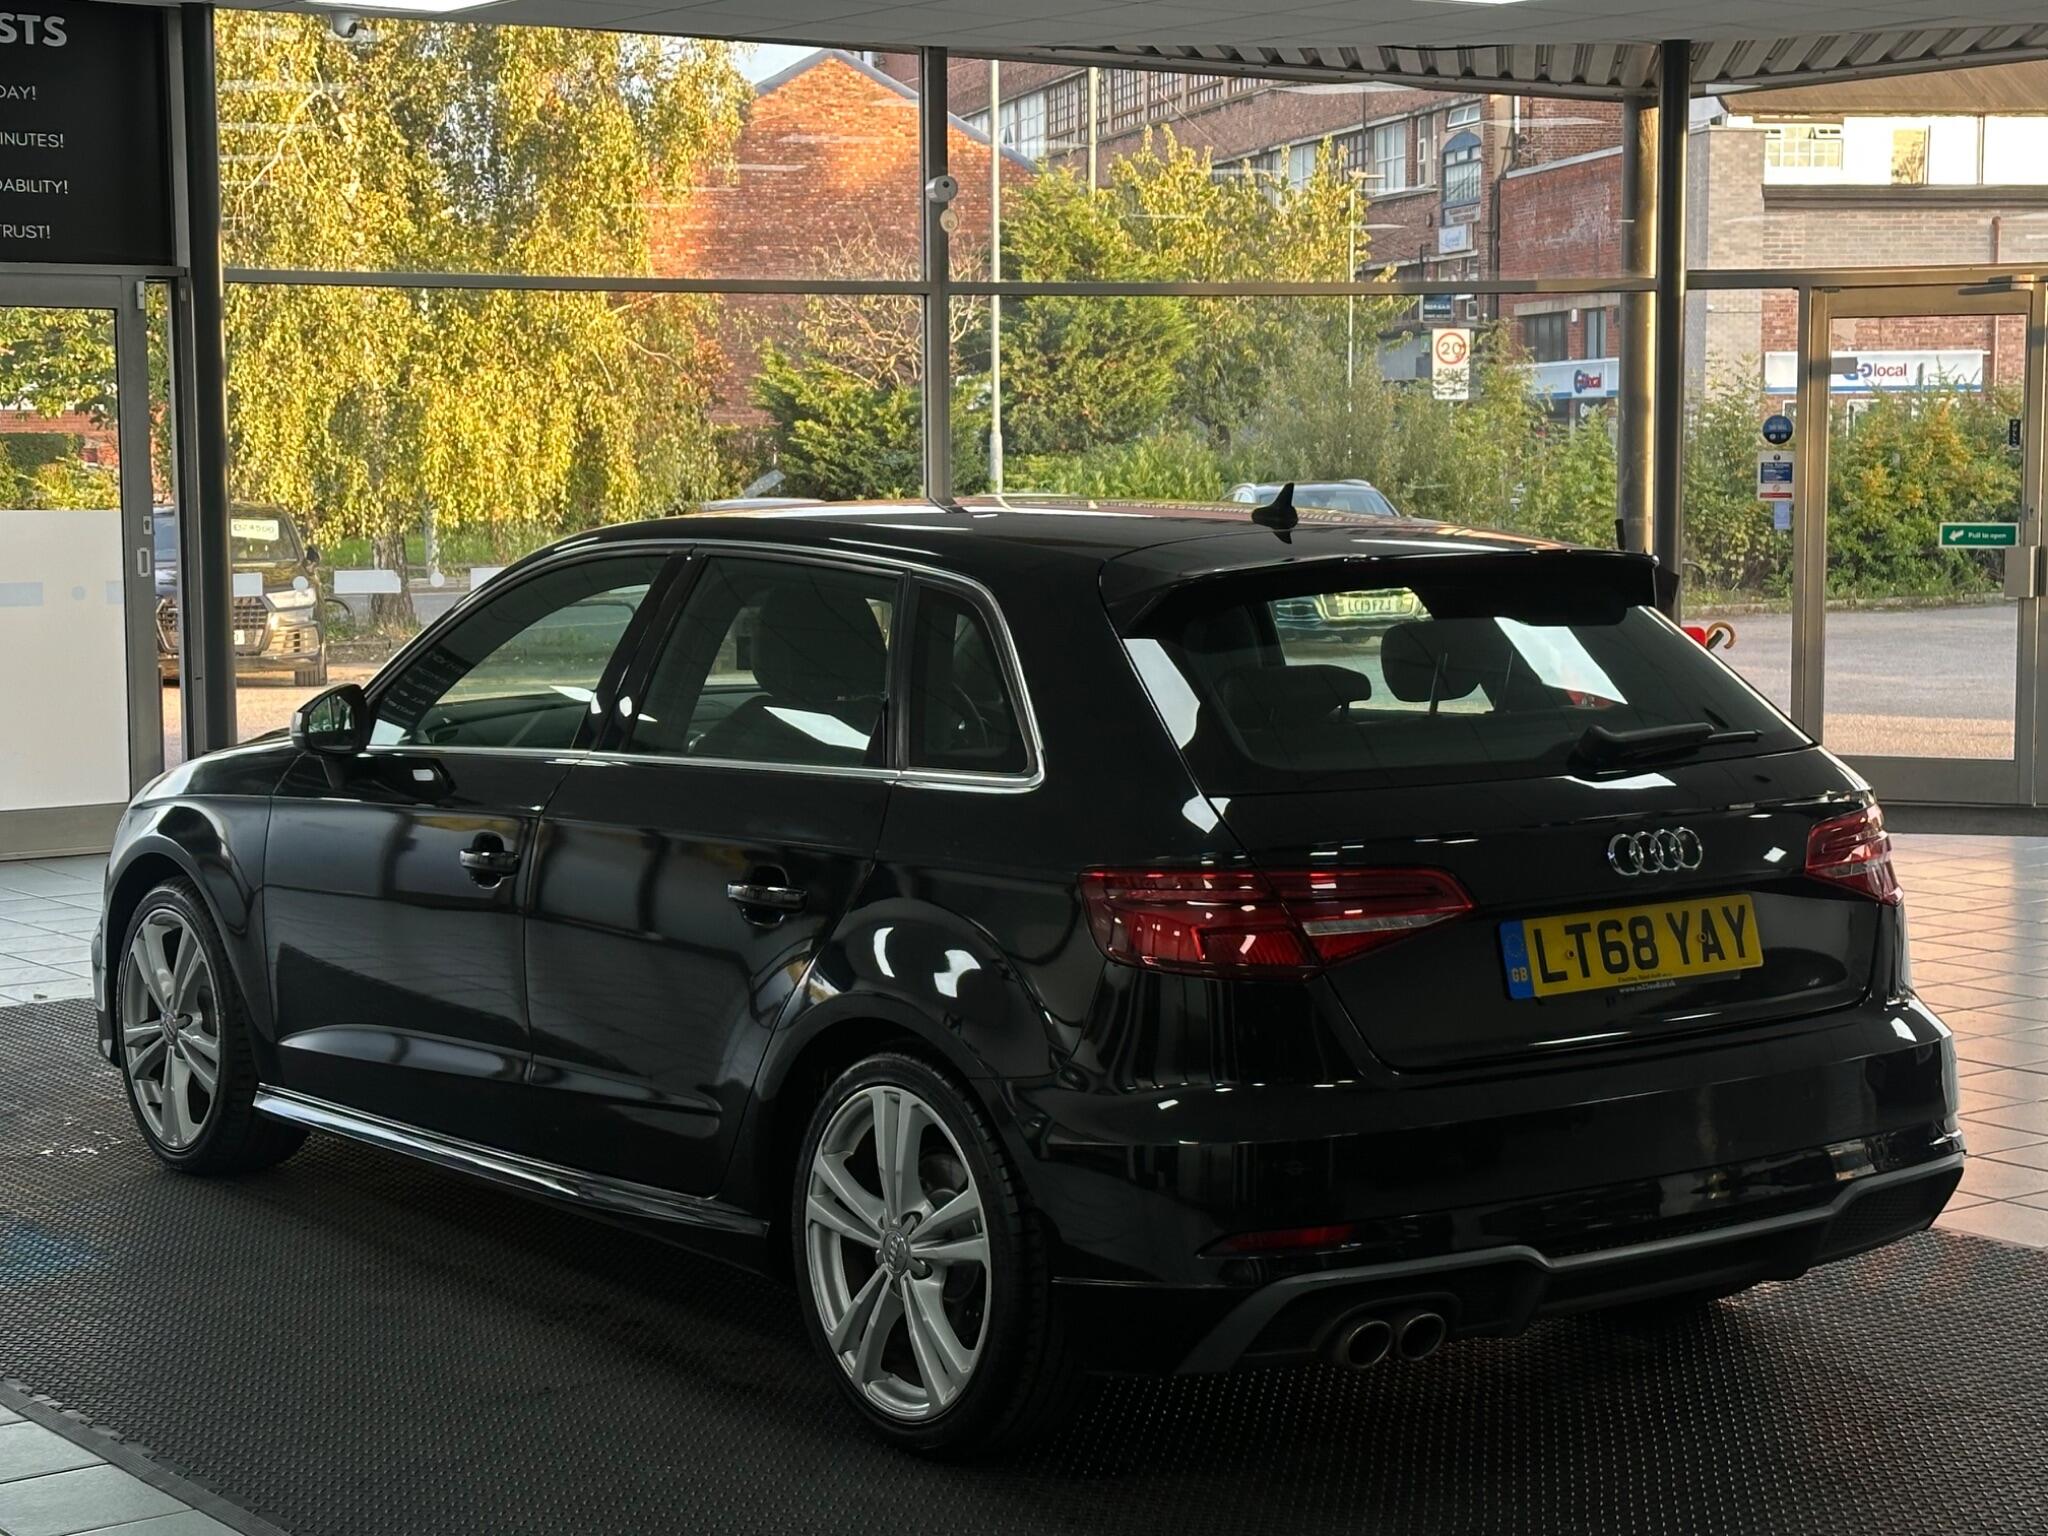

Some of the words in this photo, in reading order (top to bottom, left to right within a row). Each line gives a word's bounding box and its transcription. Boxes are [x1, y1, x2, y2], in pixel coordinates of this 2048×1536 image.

[0, 224, 51, 240] RUST!
[1440, 341, 1462, 356] 20
[1873, 362, 1908, 378] local
[1968, 531, 1981, 539] Pull
[1990, 533, 2007, 541] open
[1532, 915, 1660, 984] LT68
[1665, 904, 1746, 966] YAY
[1511, 966, 1529, 983] GB
